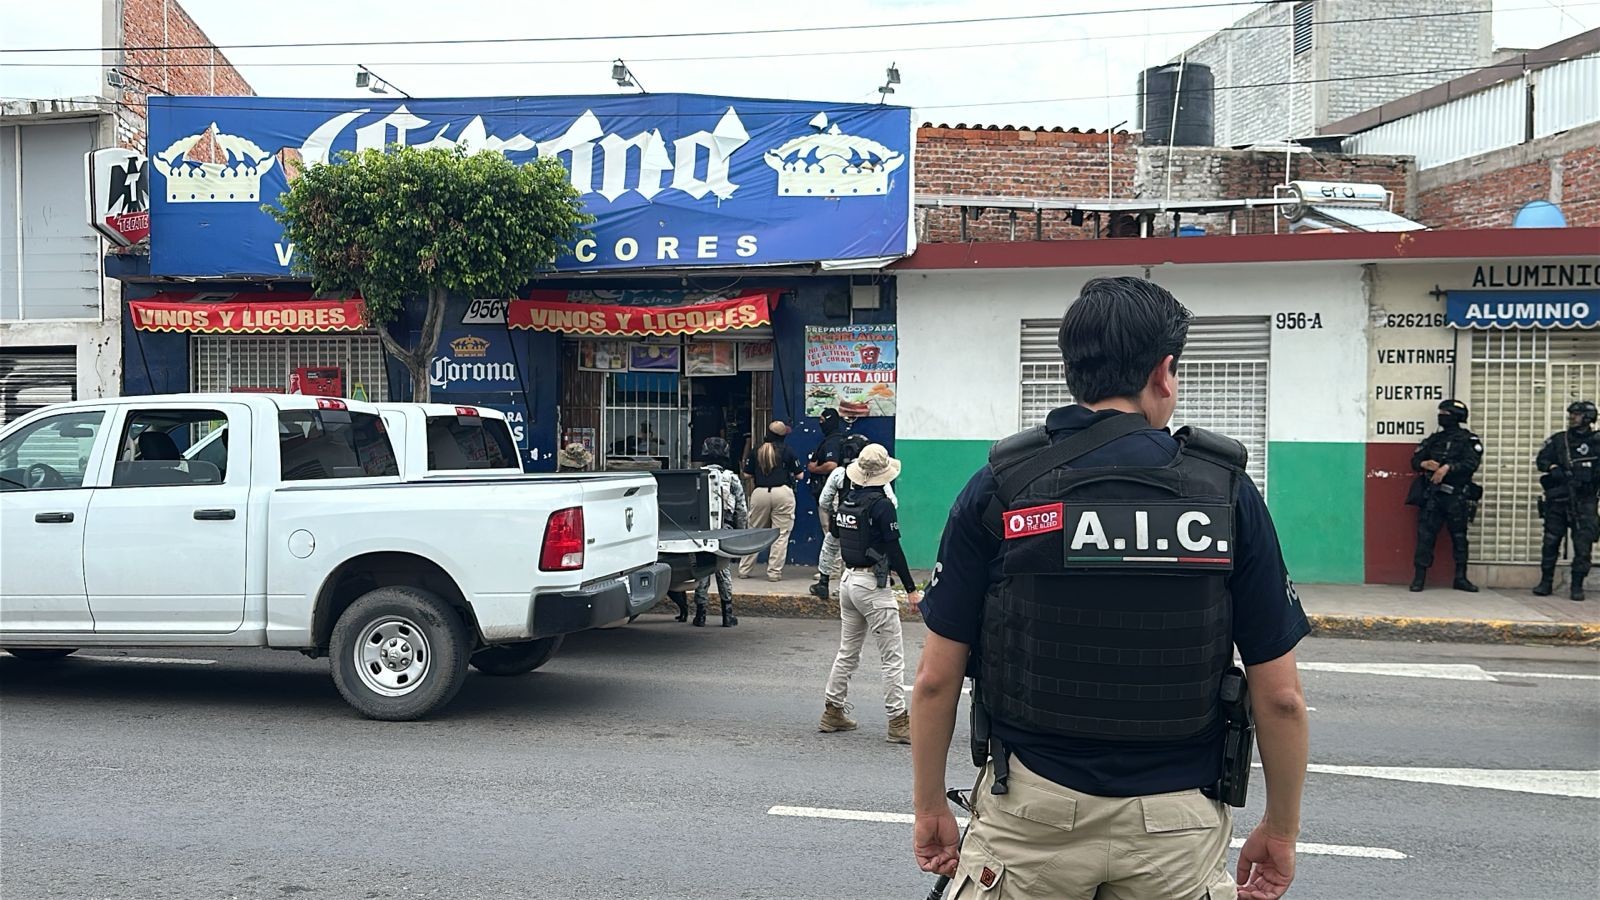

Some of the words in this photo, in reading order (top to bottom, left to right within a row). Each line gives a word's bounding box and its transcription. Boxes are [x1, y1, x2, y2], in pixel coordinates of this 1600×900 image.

[117, 214, 149, 233] TECATE
[137, 309, 209, 327] VINOS
[220, 311, 235, 327] Y
[242, 308, 346, 327] LICORES
[530, 308, 606, 329] VINOS
[615, 313, 632, 330] Y
[642, 305, 758, 330] LICORES
[1465, 303, 1590, 319] ALUMINIO
[1276, 311, 1323, 330] 956-A
[1377, 349, 1455, 364] VENTANAS
[430, 356, 516, 389] Corona
[806, 373, 820, 383] DE
[823, 372, 861, 383] VENTA
[1376, 386, 1442, 400] PUERTAS
[1376, 421, 1424, 435] DOMOS
[836, 512, 857, 525] AIC
[1026, 511, 1058, 526] STOP
[1040, 520, 1058, 529] BLEED
[1070, 510, 1228, 553] A.I.C.
